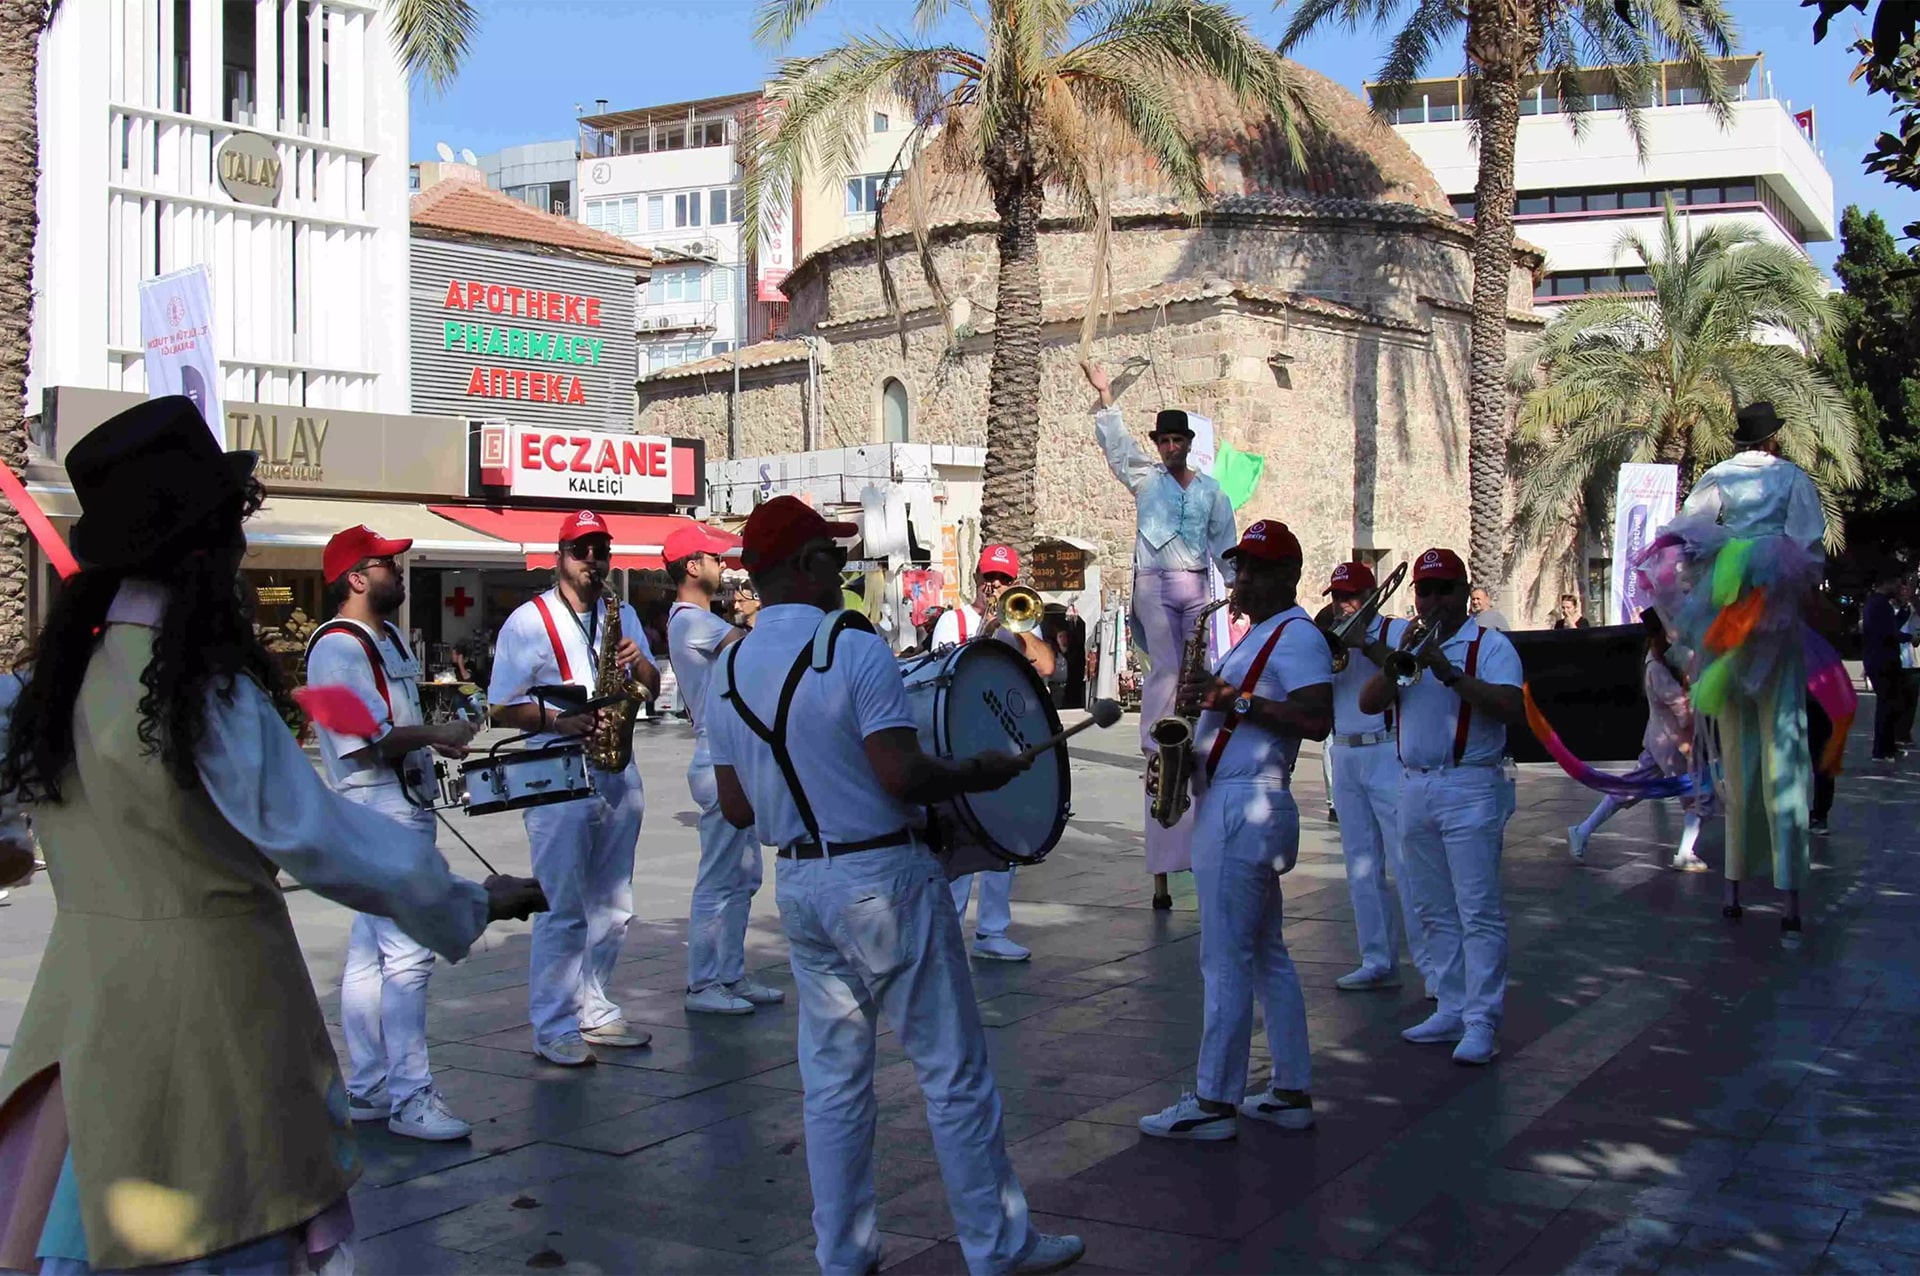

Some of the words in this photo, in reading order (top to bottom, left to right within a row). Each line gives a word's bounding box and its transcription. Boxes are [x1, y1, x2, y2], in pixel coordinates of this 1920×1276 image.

[224, 150, 281, 189] TALAY
[444, 280, 602, 327] APOTHEKE
[444, 321, 604, 365] PHARMACY
[467, 366, 586, 405] АПТЕКА
[227, 412, 329, 467] TALAY
[521, 433, 667, 478] ECZANE
[253, 464, 323, 482] UMCULUK
[569, 475, 623, 495] KALEİÇİ
